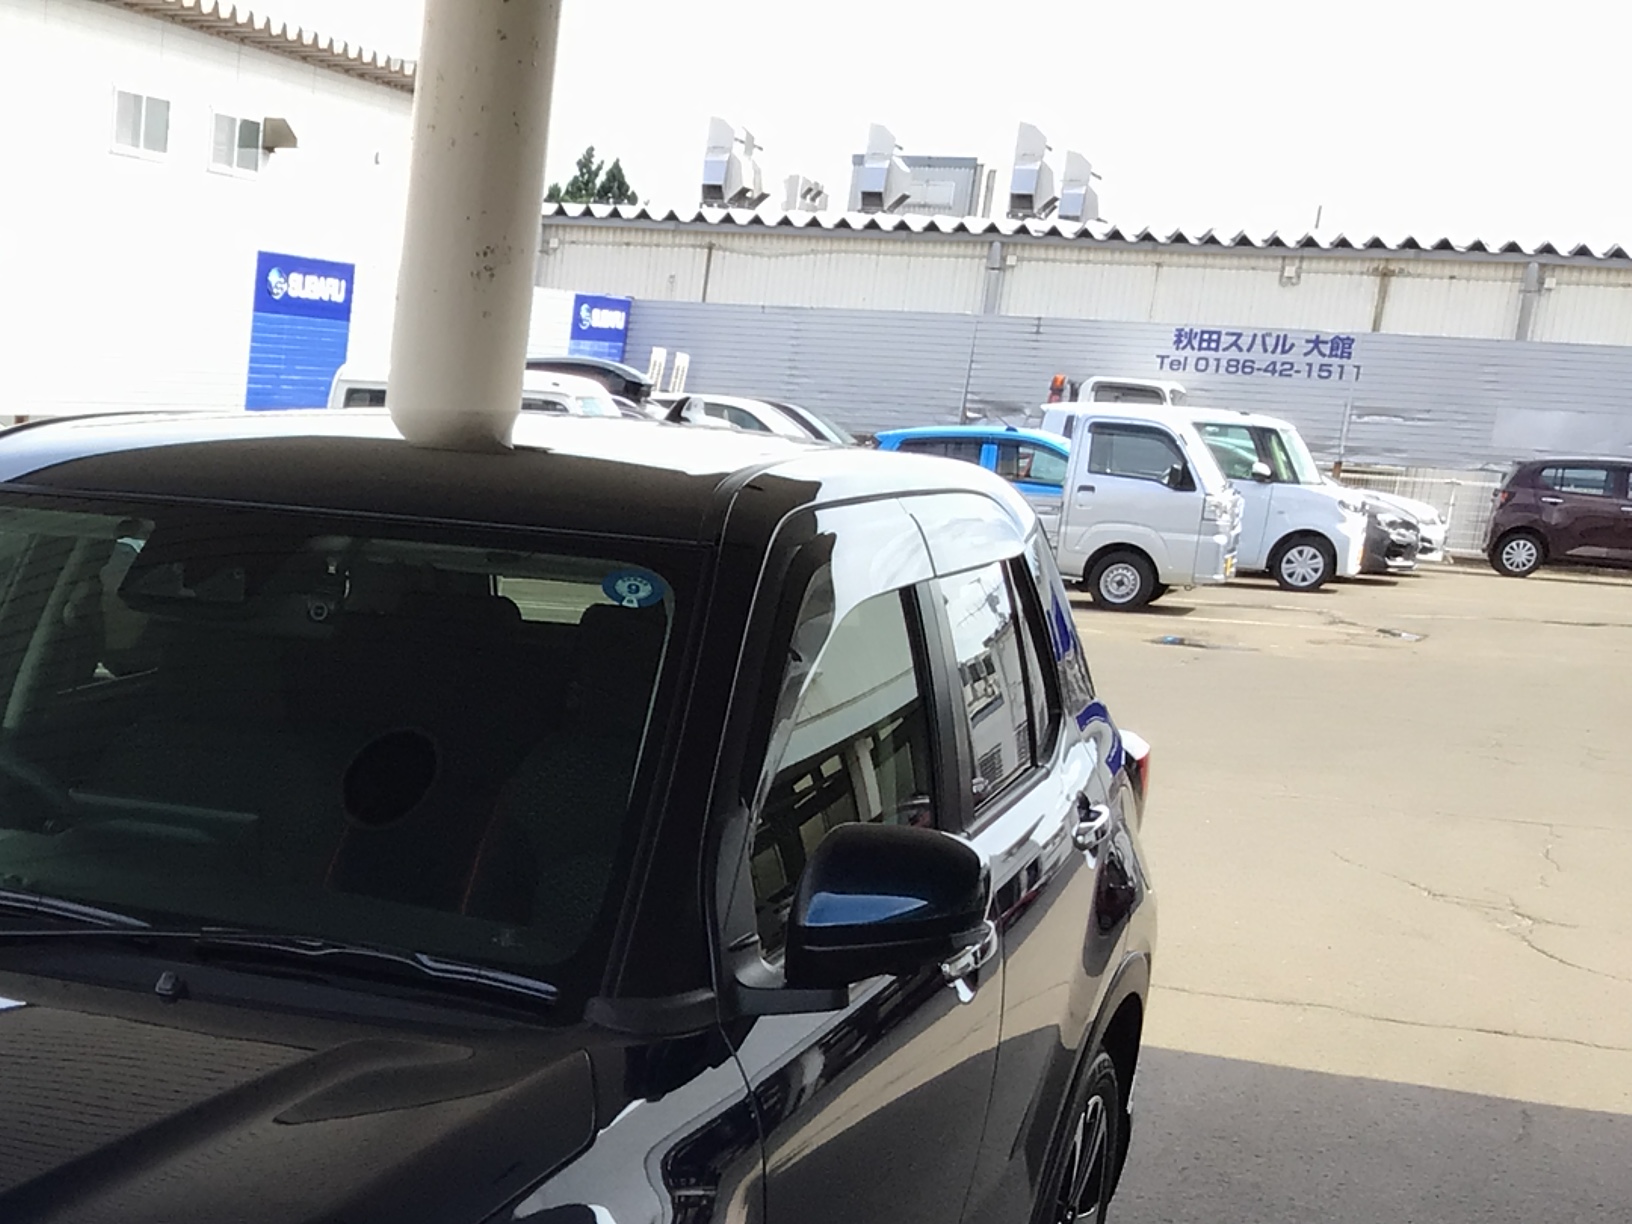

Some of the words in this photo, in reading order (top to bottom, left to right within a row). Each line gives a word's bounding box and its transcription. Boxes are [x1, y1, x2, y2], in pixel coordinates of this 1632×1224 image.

[288, 271, 346, 303] SUBARU
[1173, 327, 1296, 355] 秋田スバル
[1303, 335, 1356, 360] 大館
[1156, 355, 1188, 371] Tel
[1194, 356, 1362, 381] 0186-42-1511
